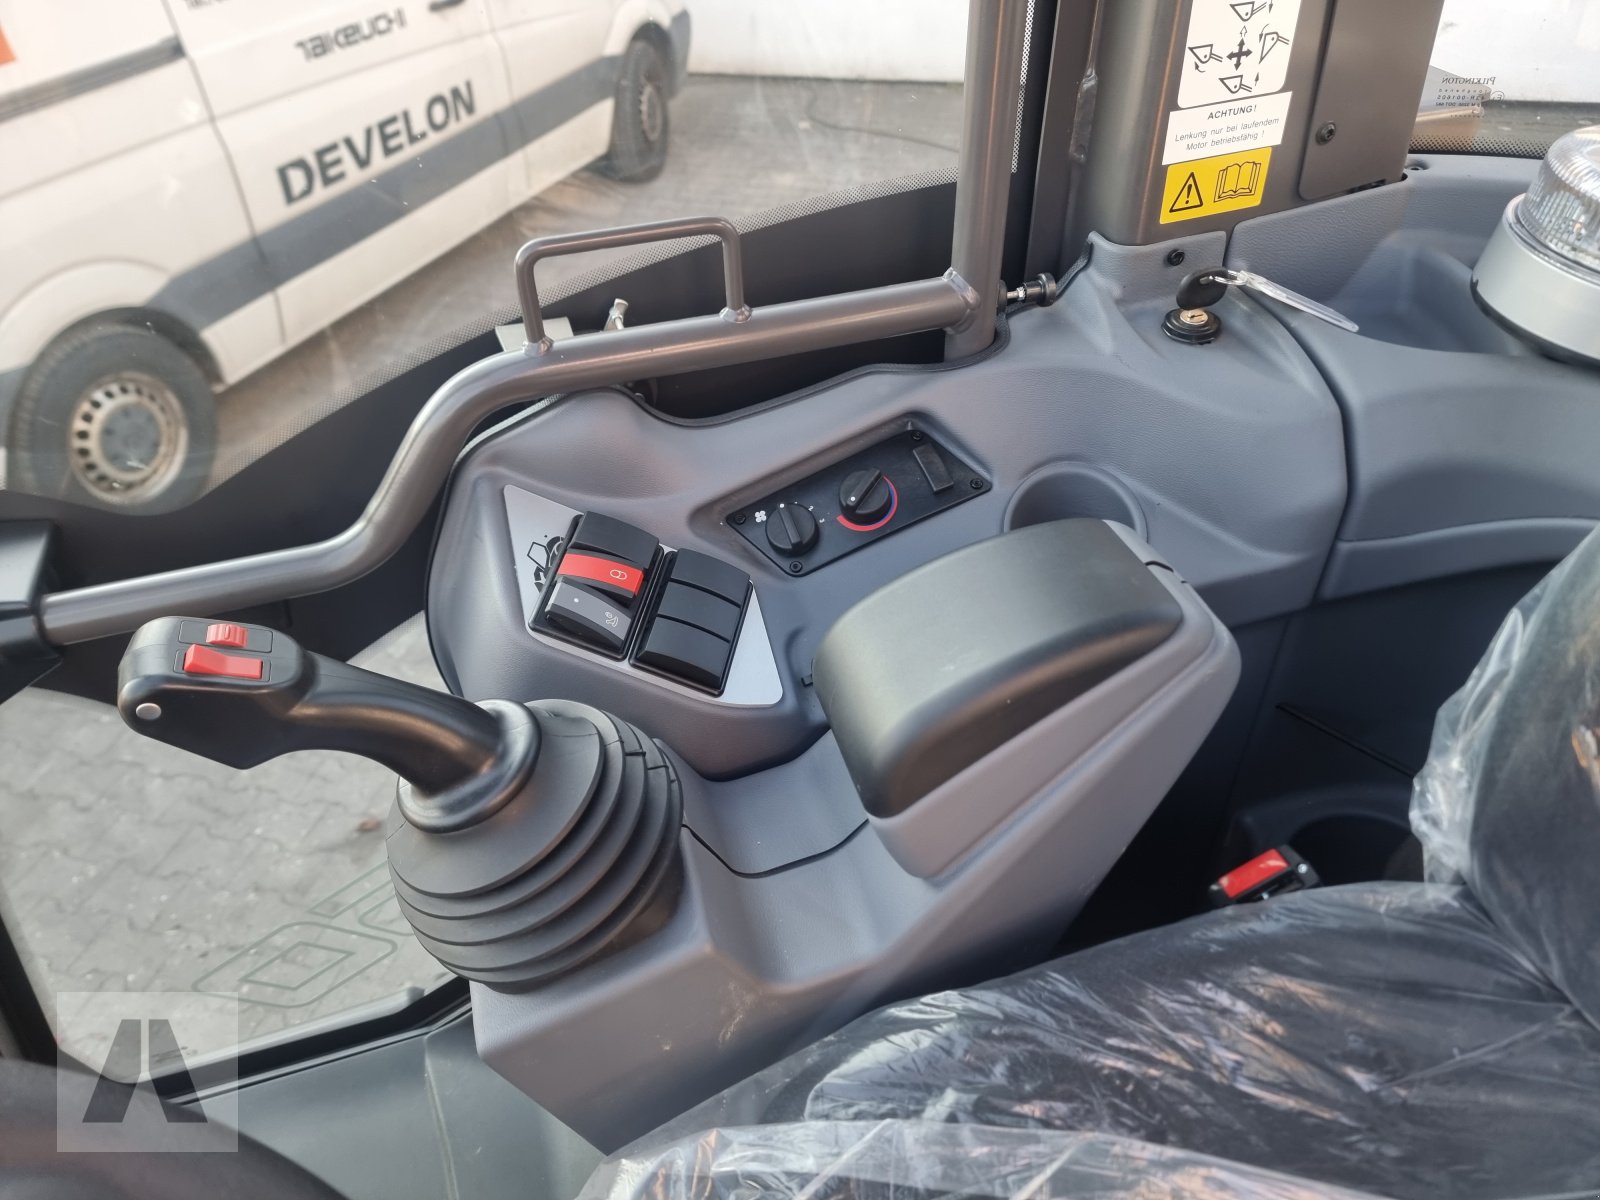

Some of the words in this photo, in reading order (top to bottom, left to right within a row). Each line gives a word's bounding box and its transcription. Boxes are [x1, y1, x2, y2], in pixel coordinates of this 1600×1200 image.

[1207, 104, 1257, 120] ACHTUNG!
[1175, 129, 1207, 142] Lenkung
[1210, 127, 1223, 136] nur
[1226, 124, 1238, 133] bei
[1240, 117, 1280, 130] laufendem
[277, 78, 476, 205] DEVELON
[1186, 141, 1208, 151] Motor
[1210, 131, 1259, 147] betriebsfähig
